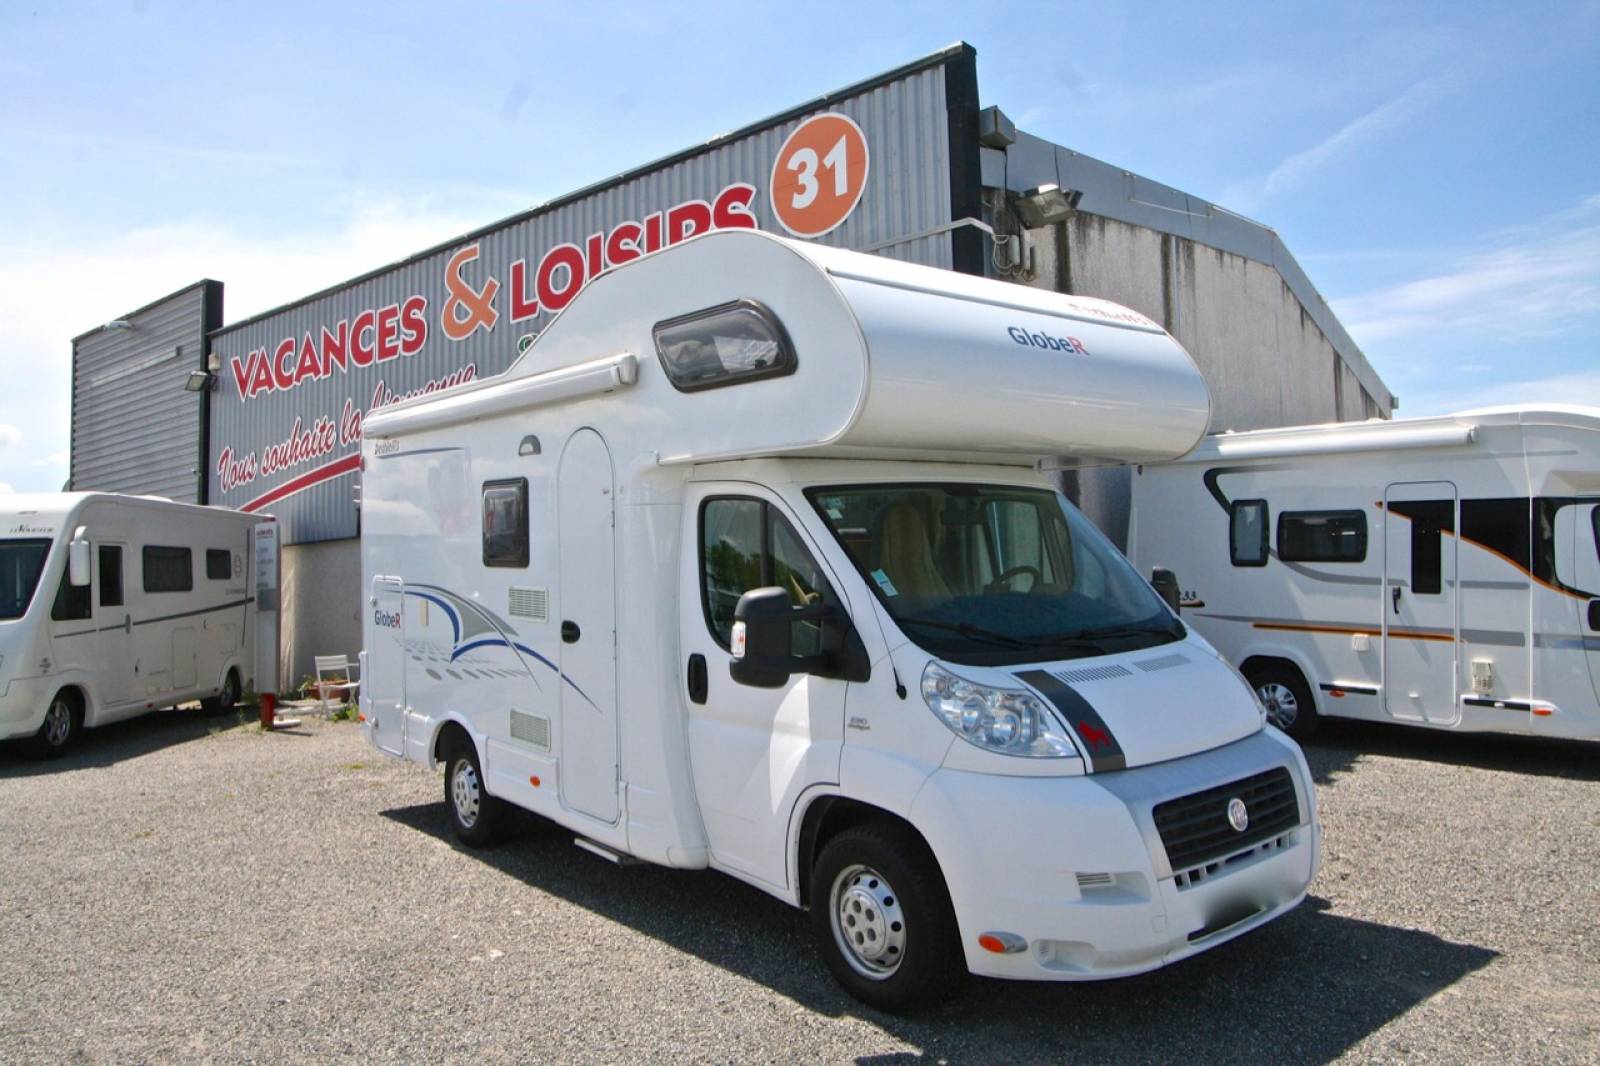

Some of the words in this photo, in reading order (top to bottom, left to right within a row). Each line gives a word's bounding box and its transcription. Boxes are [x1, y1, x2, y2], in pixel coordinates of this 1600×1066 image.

[785, 133, 848, 210] 31
[231, 295, 427, 402] VACANCES
[441, 242, 500, 341] &
[1007, 326, 1090, 356] GlobeR
[217, 446, 258, 494] Vous
[261, 415, 337, 477] souhaite
[340, 397, 362, 447] la
[374, 609, 401, 629] GlobeR
